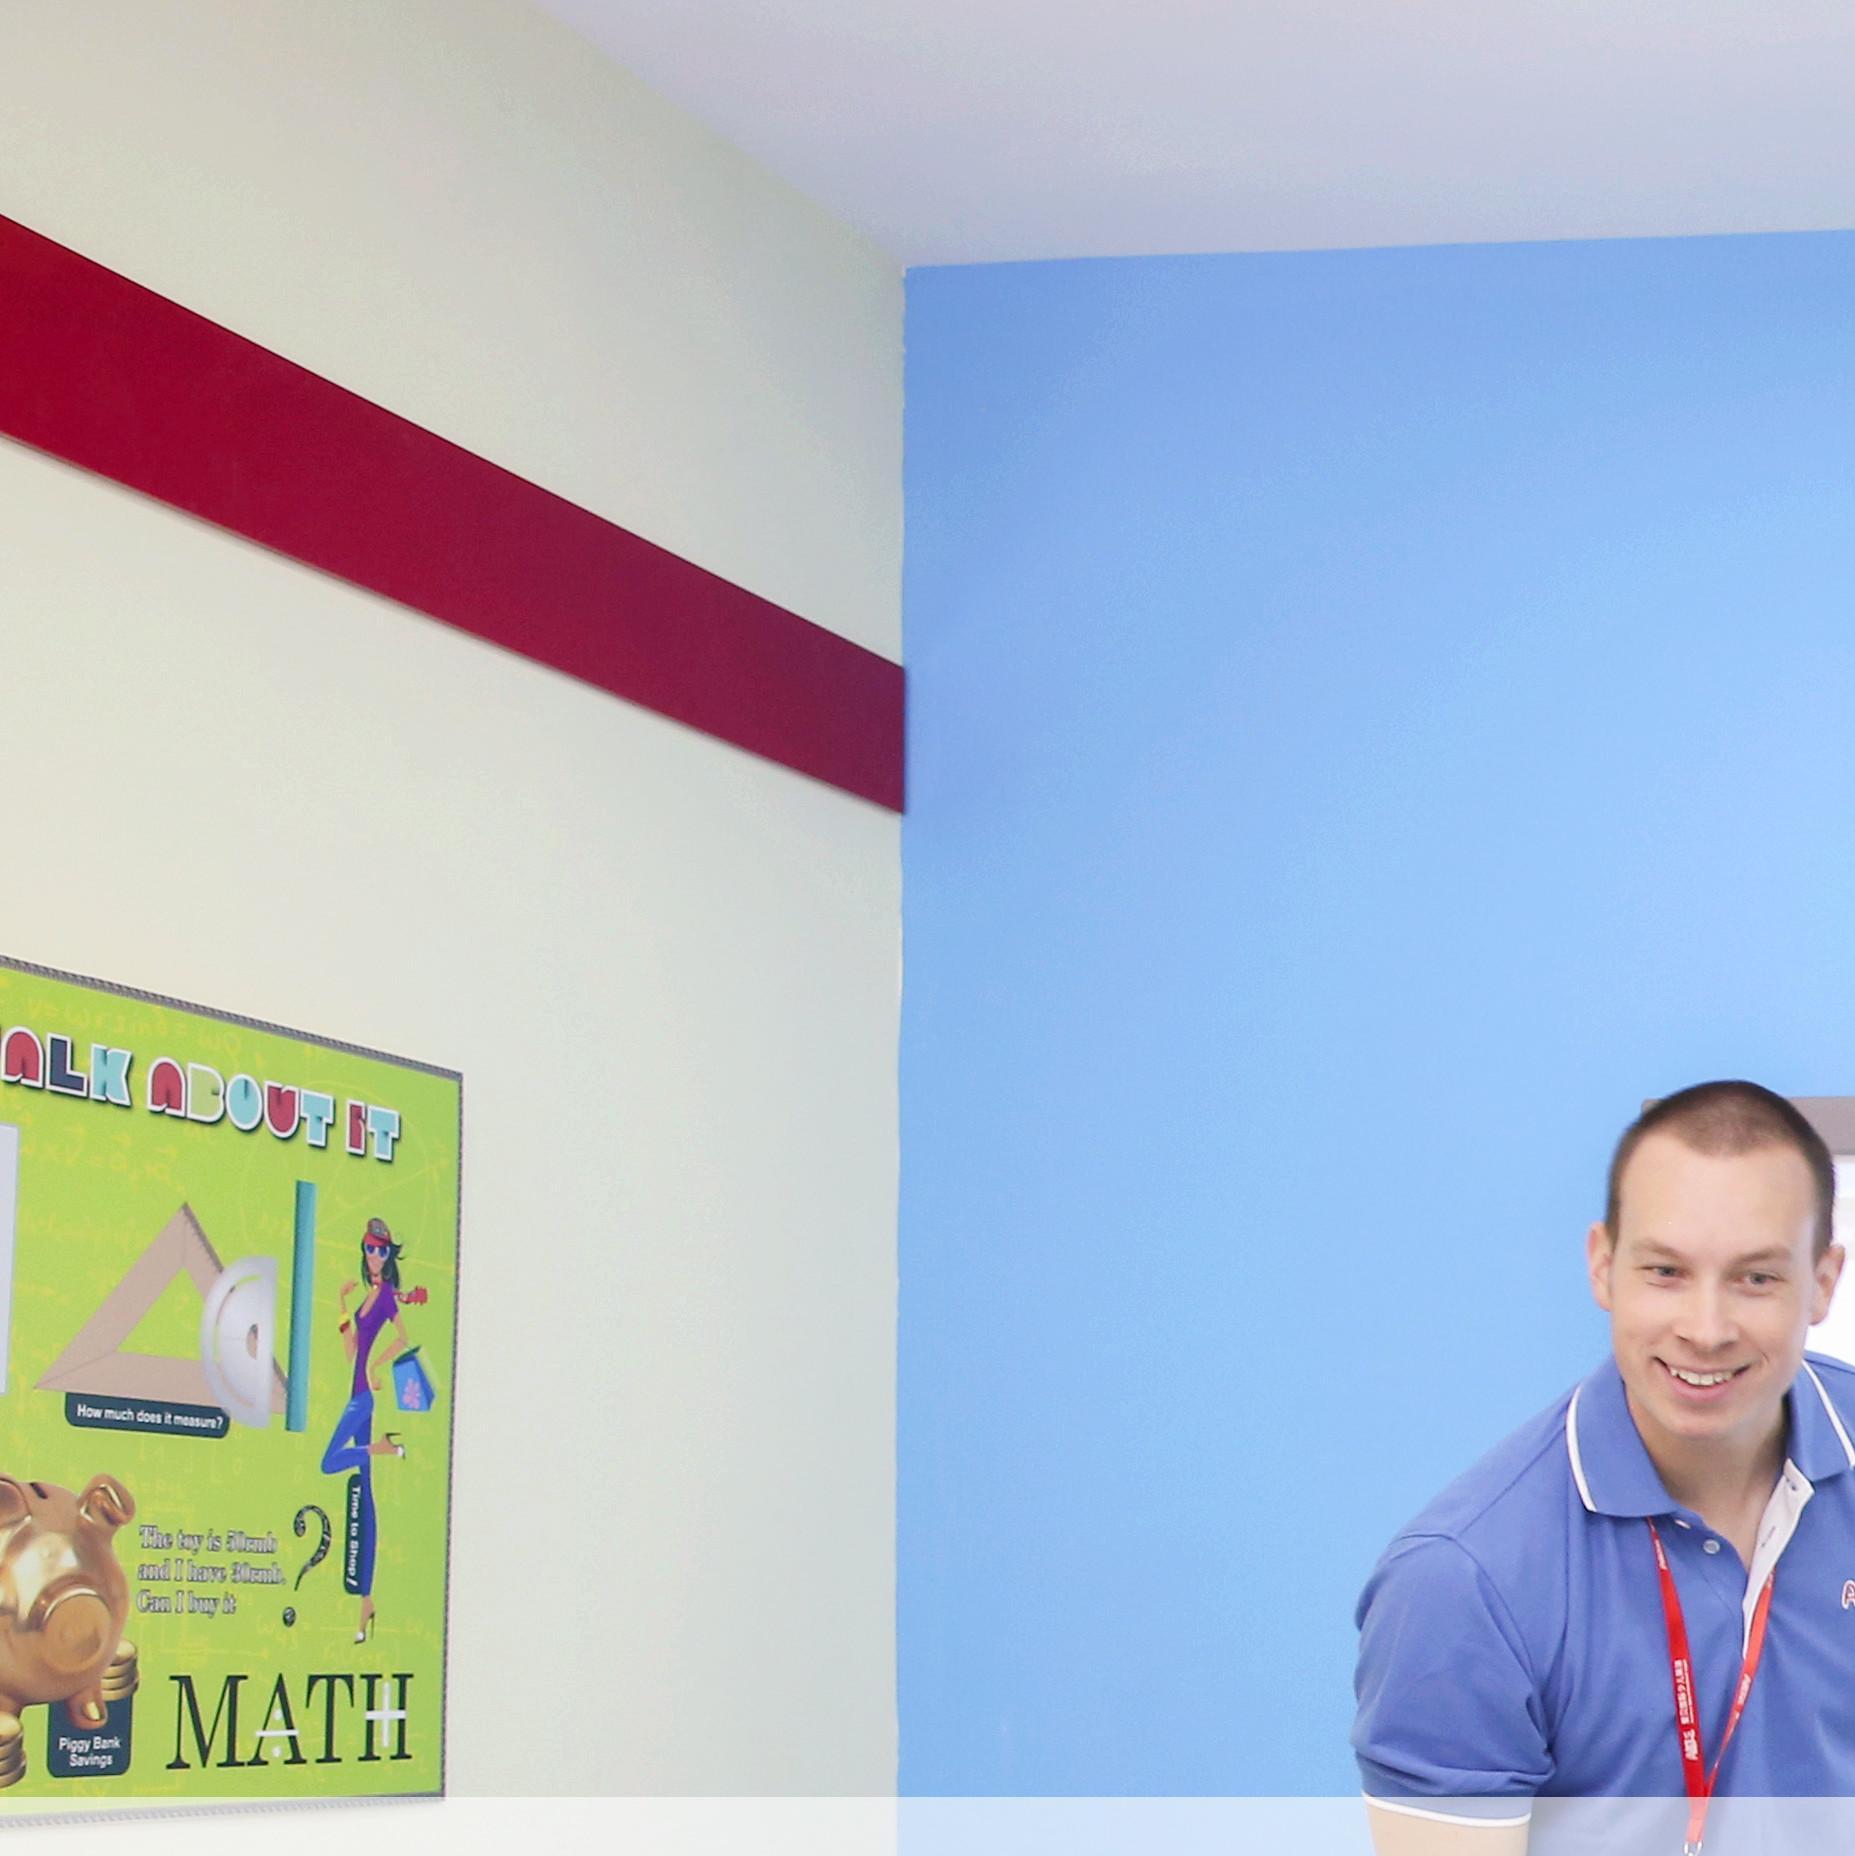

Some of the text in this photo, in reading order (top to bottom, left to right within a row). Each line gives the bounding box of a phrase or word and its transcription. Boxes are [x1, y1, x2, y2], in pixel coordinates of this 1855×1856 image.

[0, 1026, 399, 1161] ALK ABOUT IT
[76, 1403, 223, 1429] How much does it measure?
[351, 1485, 361, 1519] Time
[139, 1524, 173, 1549] The
[177, 1529, 203, 1556] toy
[207, 1529, 222, 1552] is
[350, 1522, 359, 1536] to
[137, 1559, 170, 1581] and
[175, 1559, 184, 1581] I
[187, 1559, 227, 1583] have
[137, 1589, 171, 1613] Can
[175, 1590, 184, 1614] I
[188, 1591, 219, 1619] buy
[223, 1592, 236, 1614] it
[165, 1672, 414, 1770] MATH
[59, 1736, 120, 1752] Piggy Bank
[69, 1753, 113, 1768] Savings
